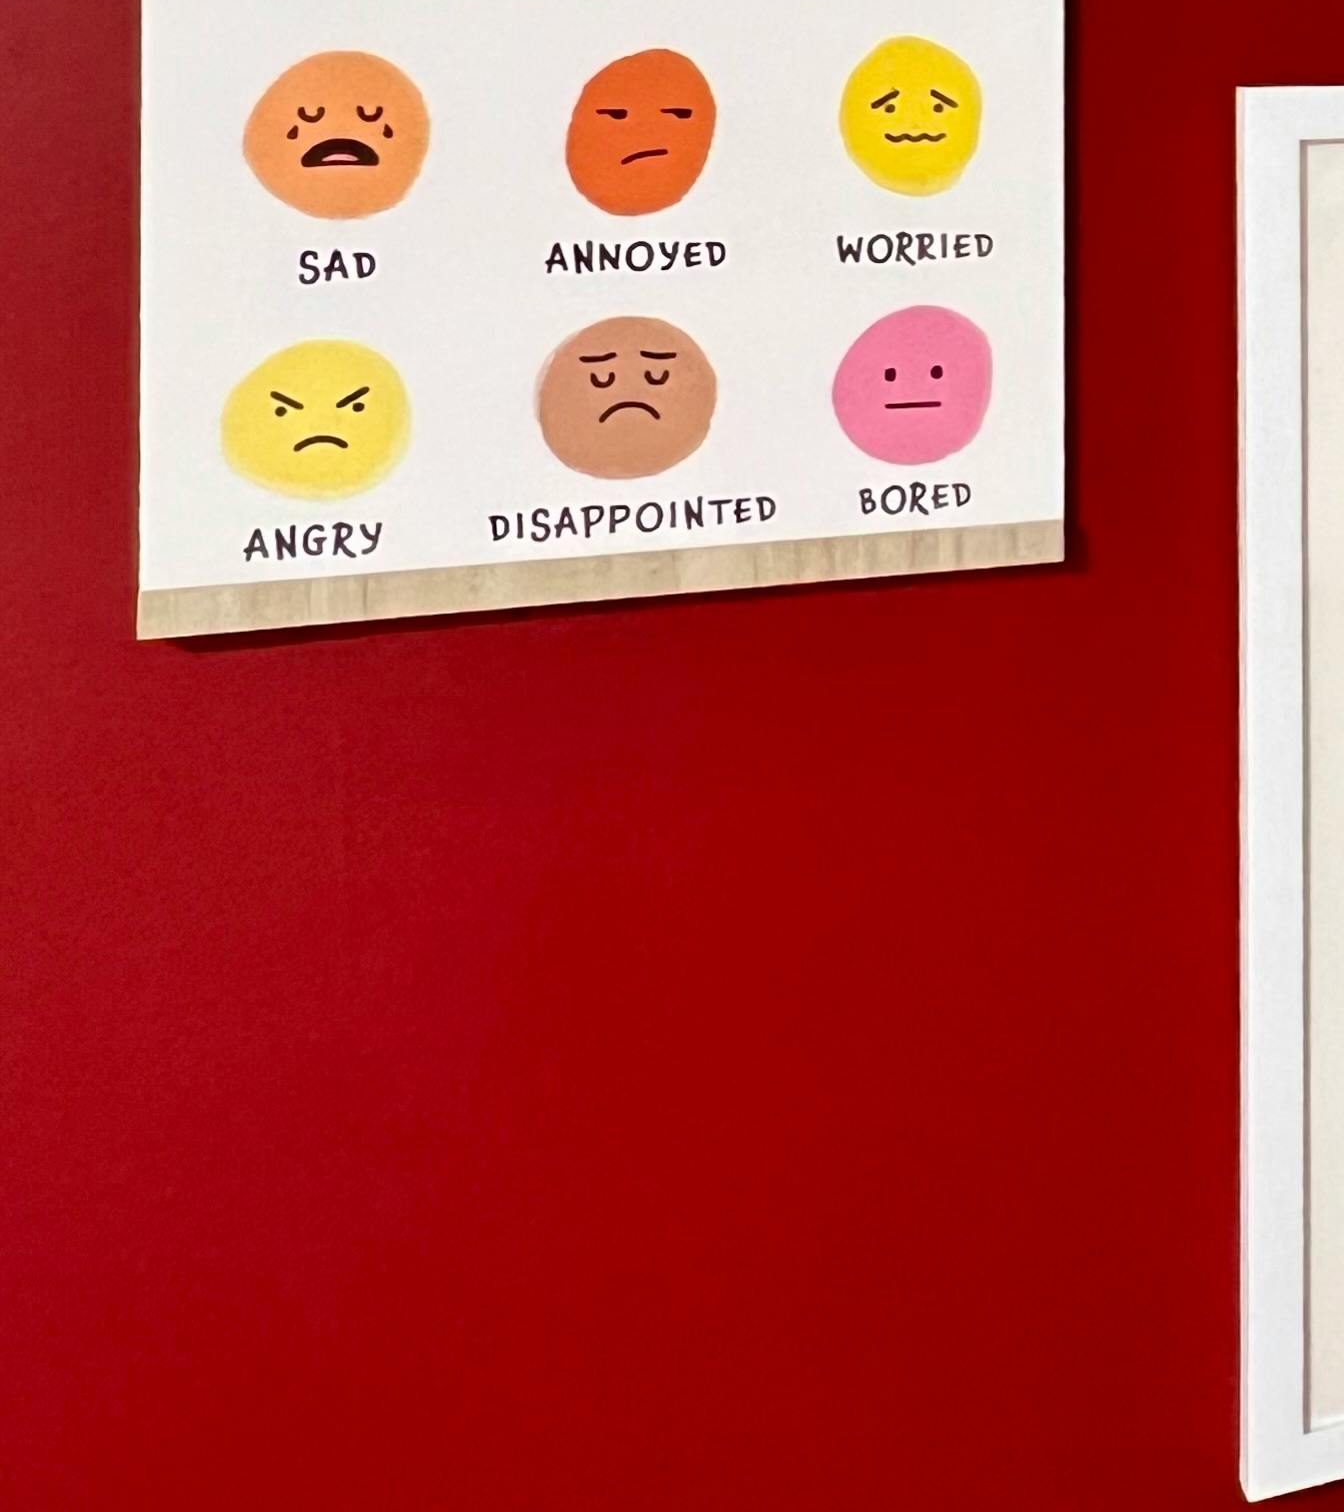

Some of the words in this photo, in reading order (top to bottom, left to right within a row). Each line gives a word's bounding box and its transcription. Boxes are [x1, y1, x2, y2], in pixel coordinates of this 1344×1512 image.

[298, 248, 377, 286] SAD
[544, 239, 727, 275] ANNOYED
[836, 230, 994, 267] WORRIED
[858, 480, 972, 517] BORED
[487, 495, 777, 543] DISAPPOINTED
[242, 520, 384, 563] ANGRY
